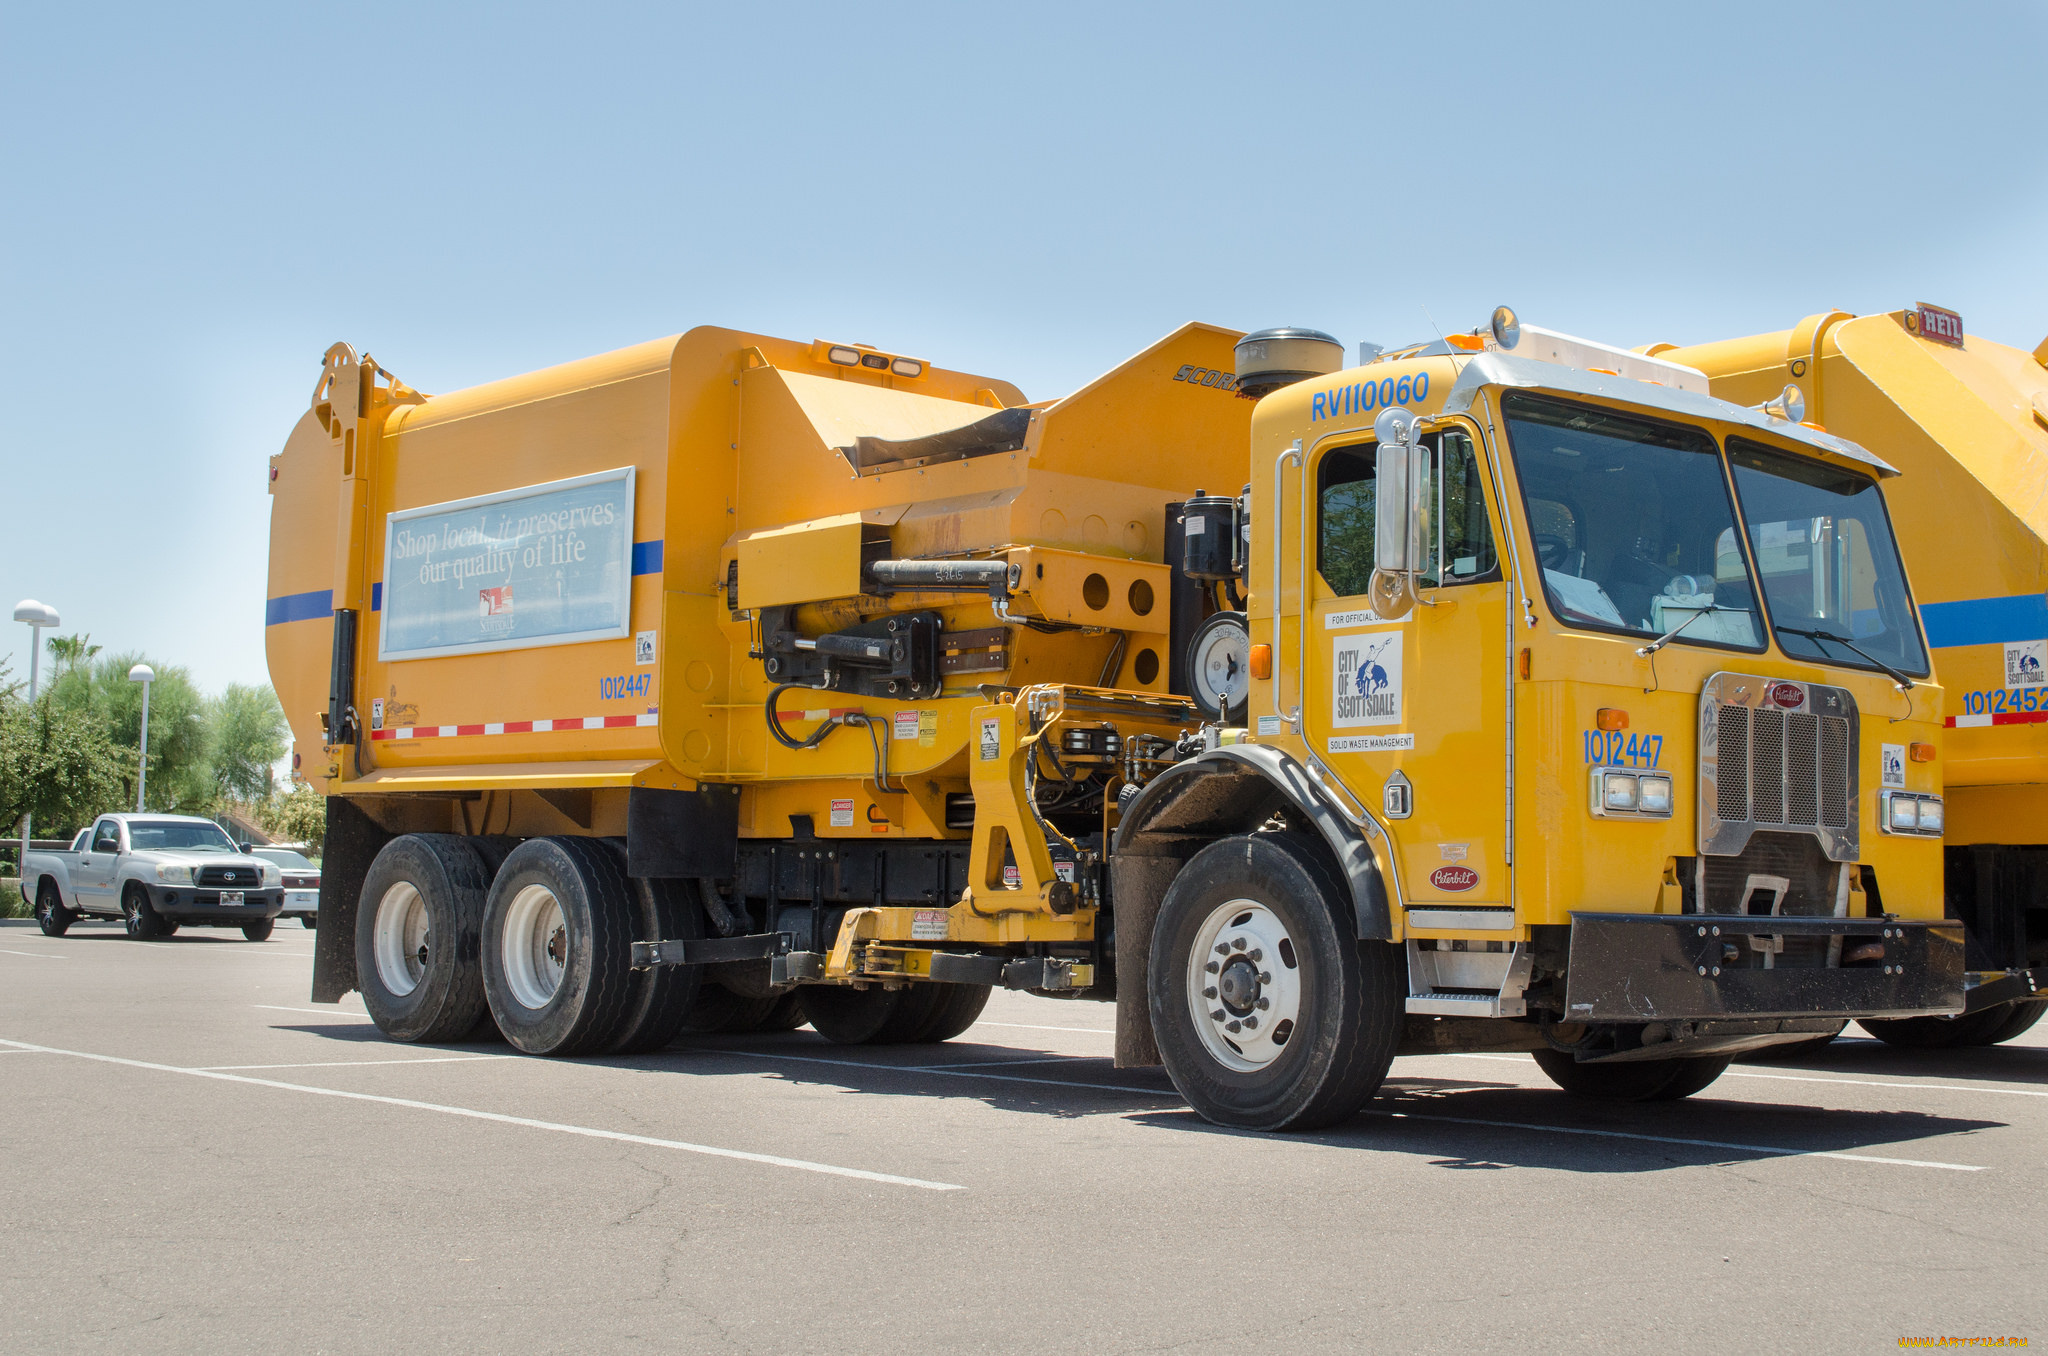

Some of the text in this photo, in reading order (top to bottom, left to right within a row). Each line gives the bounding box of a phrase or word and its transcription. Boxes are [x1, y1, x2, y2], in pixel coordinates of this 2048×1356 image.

[1925, 311, 1961, 339] HEIL
[1312, 372, 1429, 422] RV110060
[396, 529, 436, 563] Shop
[513, 502, 614, 549] preserves
[419, 531, 586, 590] our quality of life
[1332, 615, 1344, 625] FOR
[1346, 613, 1373, 623] OFFICIAL
[1338, 650, 1359, 673] CITY
[2007, 650, 2020, 662] CITY
[2008, 662, 2015, 673] OF
[600, 673, 651, 700] 1012447
[1338, 674, 1349, 696] OF
[2008, 671, 2044, 685] SCOTTSDALE
[1338, 693, 1395, 719] SCOTTSDALE
[1963, 687, 2048, 715] 1012452
[1330, 737, 1412, 750] SOLID WASTE MANAGEMENT
[1584, 729, 1663, 767] 1012447
[1434, 870, 1474, 885] Peterbilt
